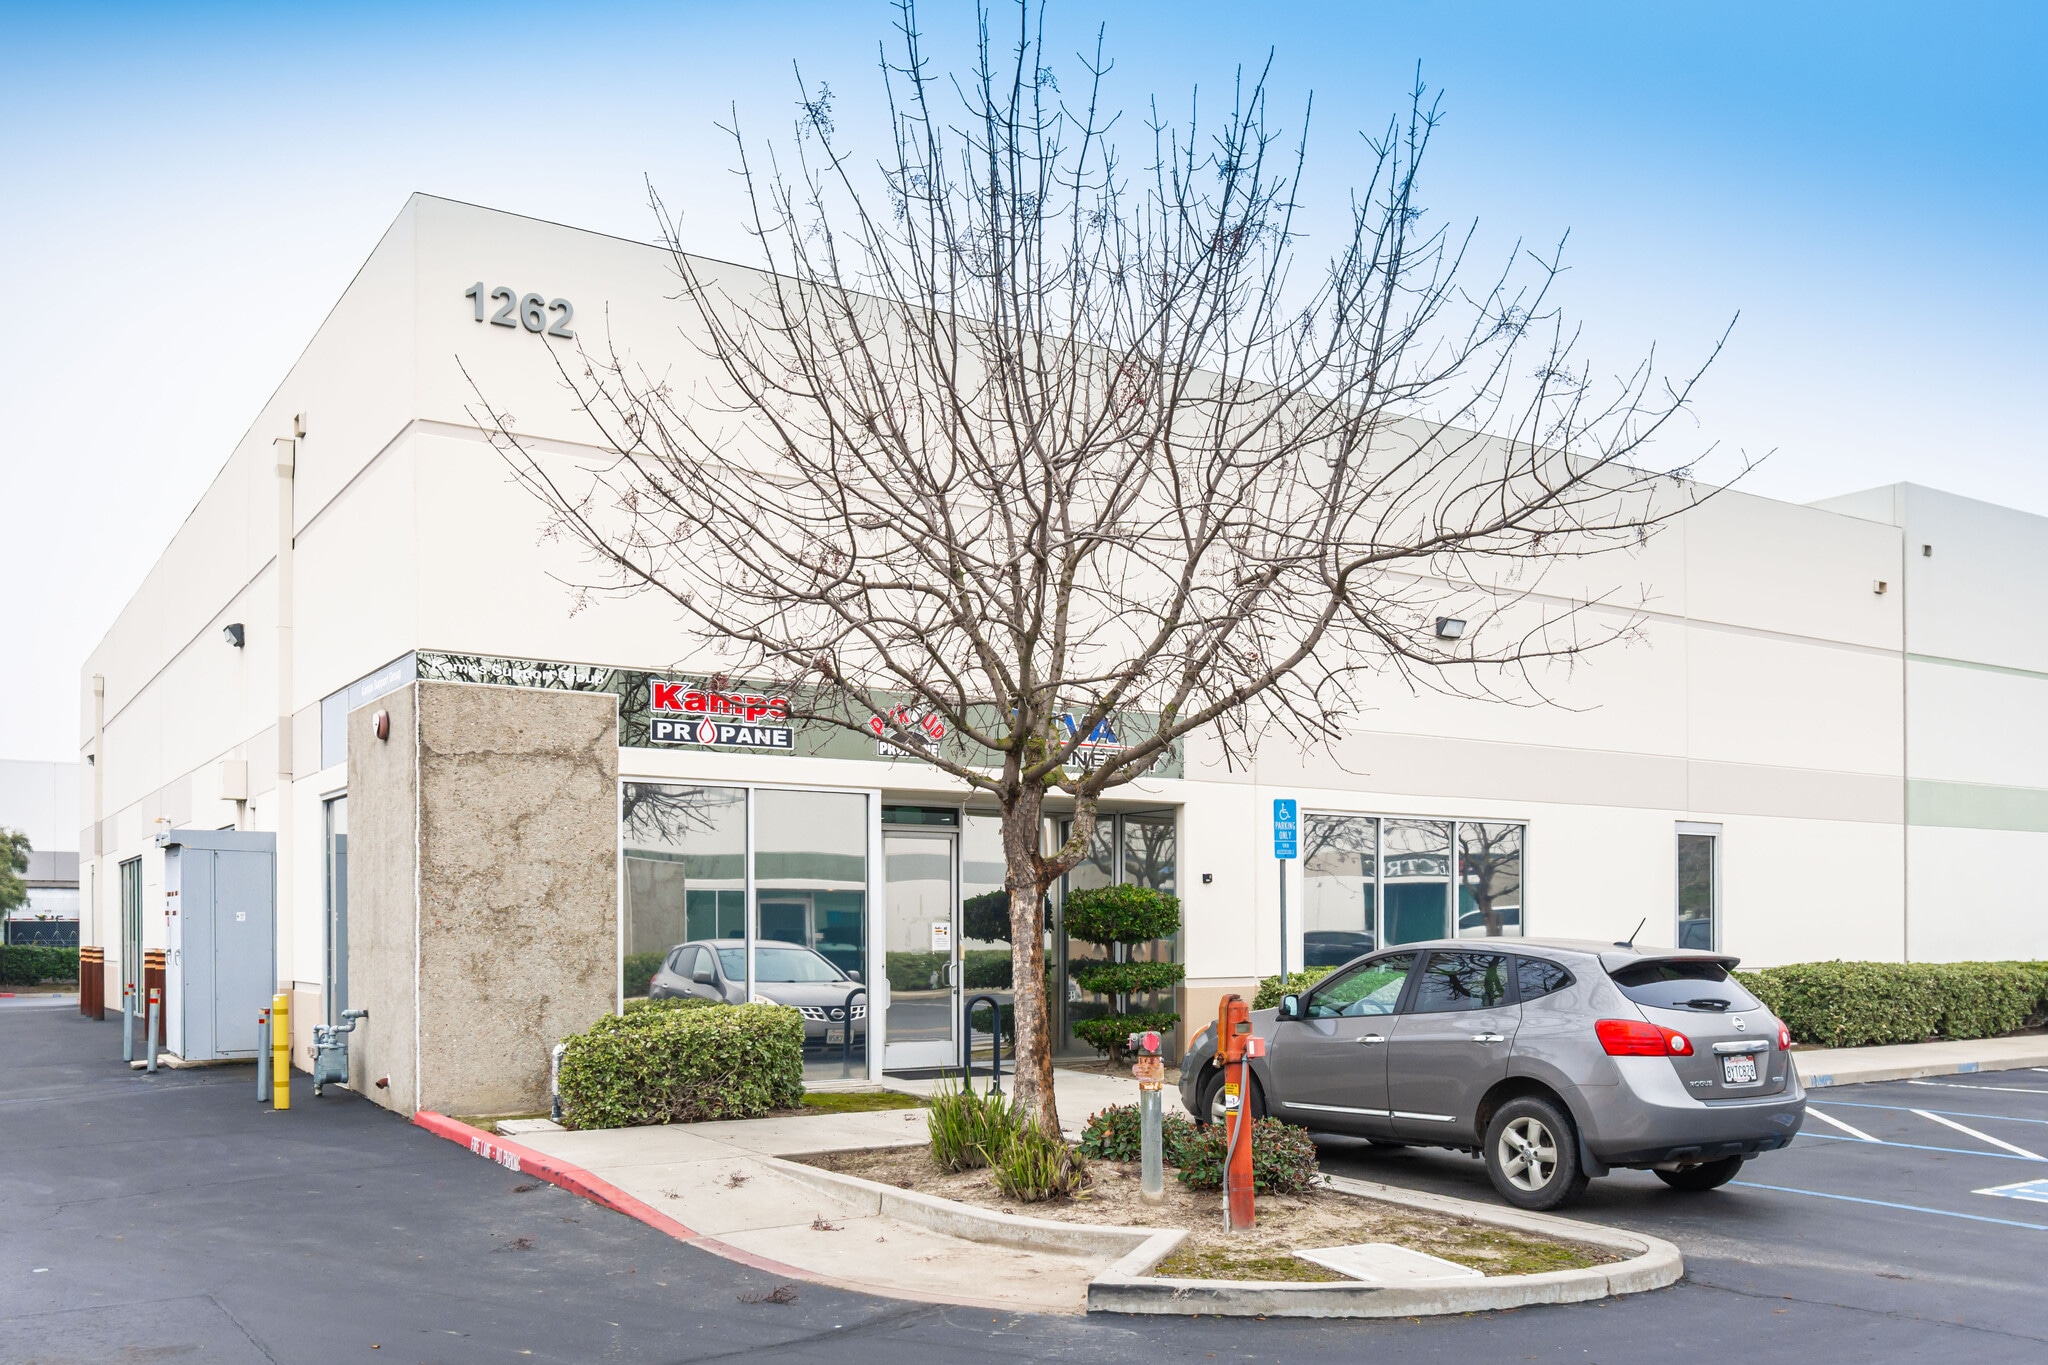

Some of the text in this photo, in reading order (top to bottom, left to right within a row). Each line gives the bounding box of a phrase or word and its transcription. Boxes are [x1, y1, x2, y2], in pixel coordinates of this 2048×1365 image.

[465, 281, 574, 339] 1262
[653, 681, 791, 723] Kamps
[1275, 822, 1296, 831] PARKING
[1279, 831, 1292, 840] ONLY
[1689, 1080, 1713, 1088] ROGUE
